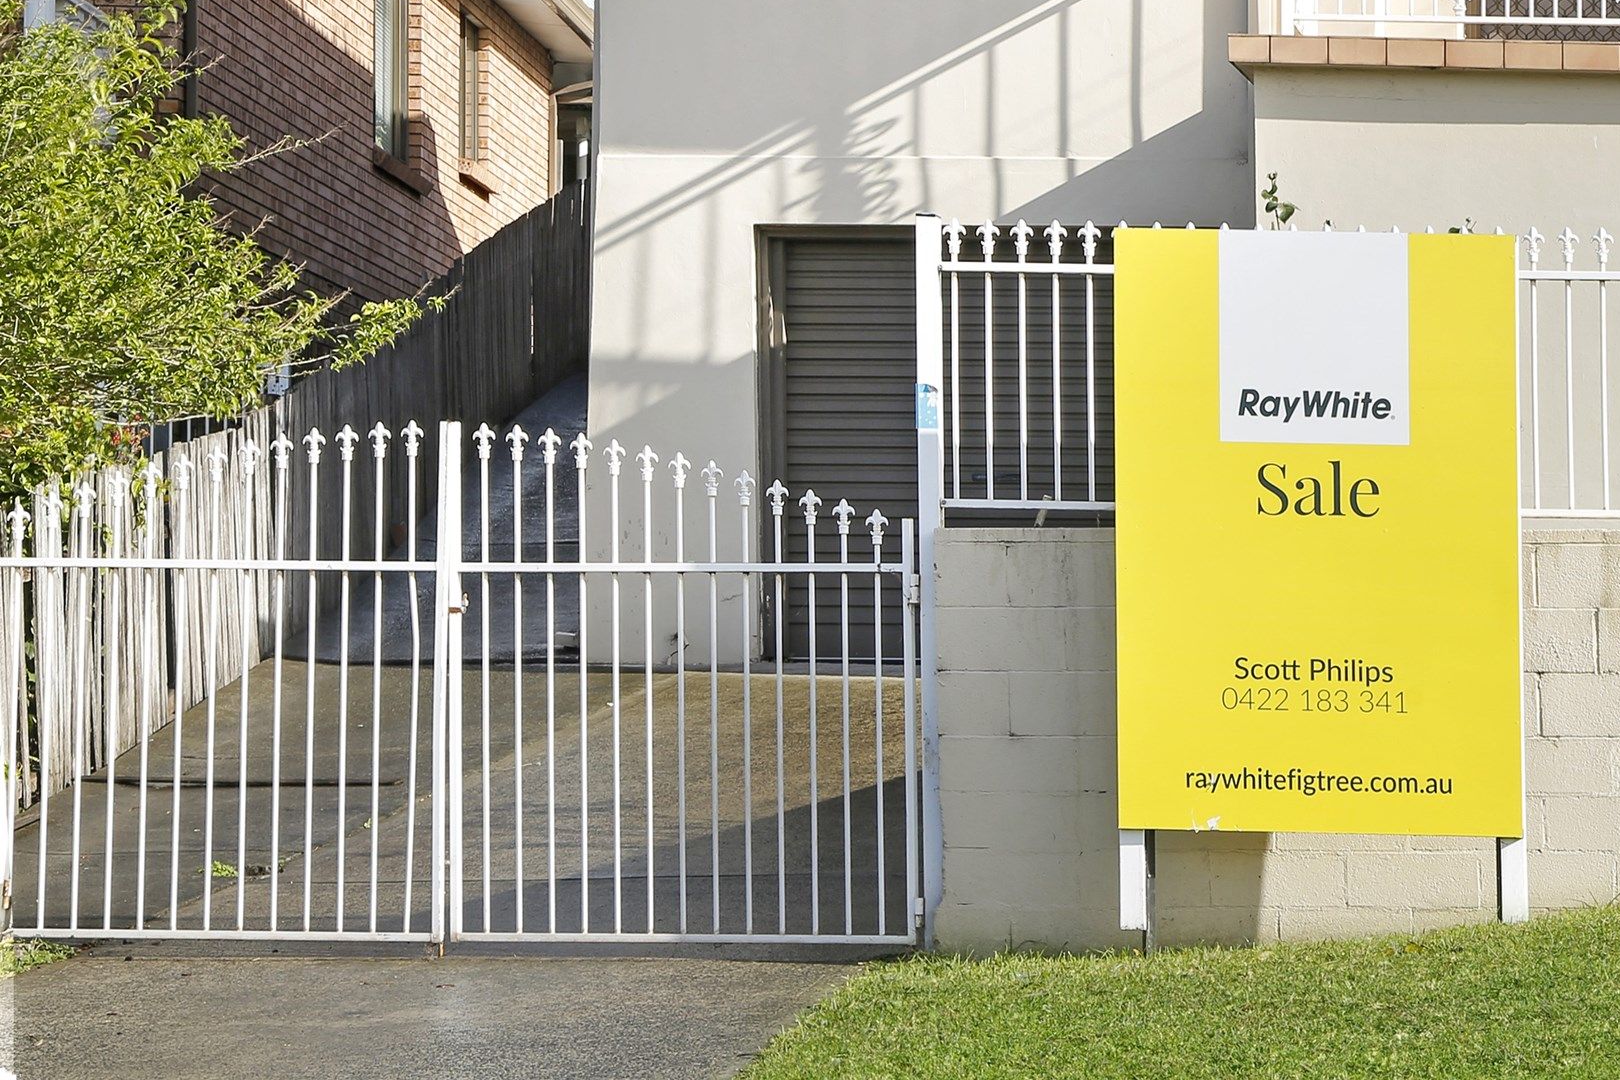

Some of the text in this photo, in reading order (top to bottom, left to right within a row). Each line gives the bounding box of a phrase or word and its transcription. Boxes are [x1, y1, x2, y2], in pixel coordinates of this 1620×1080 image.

[1257, 460, 1380, 518] Sale
[1234, 656, 1394, 687] Scott Philips
[1222, 687, 1408, 714] 0422 183 341
[1185, 766, 1453, 796] raywhitefigtree.com.au
